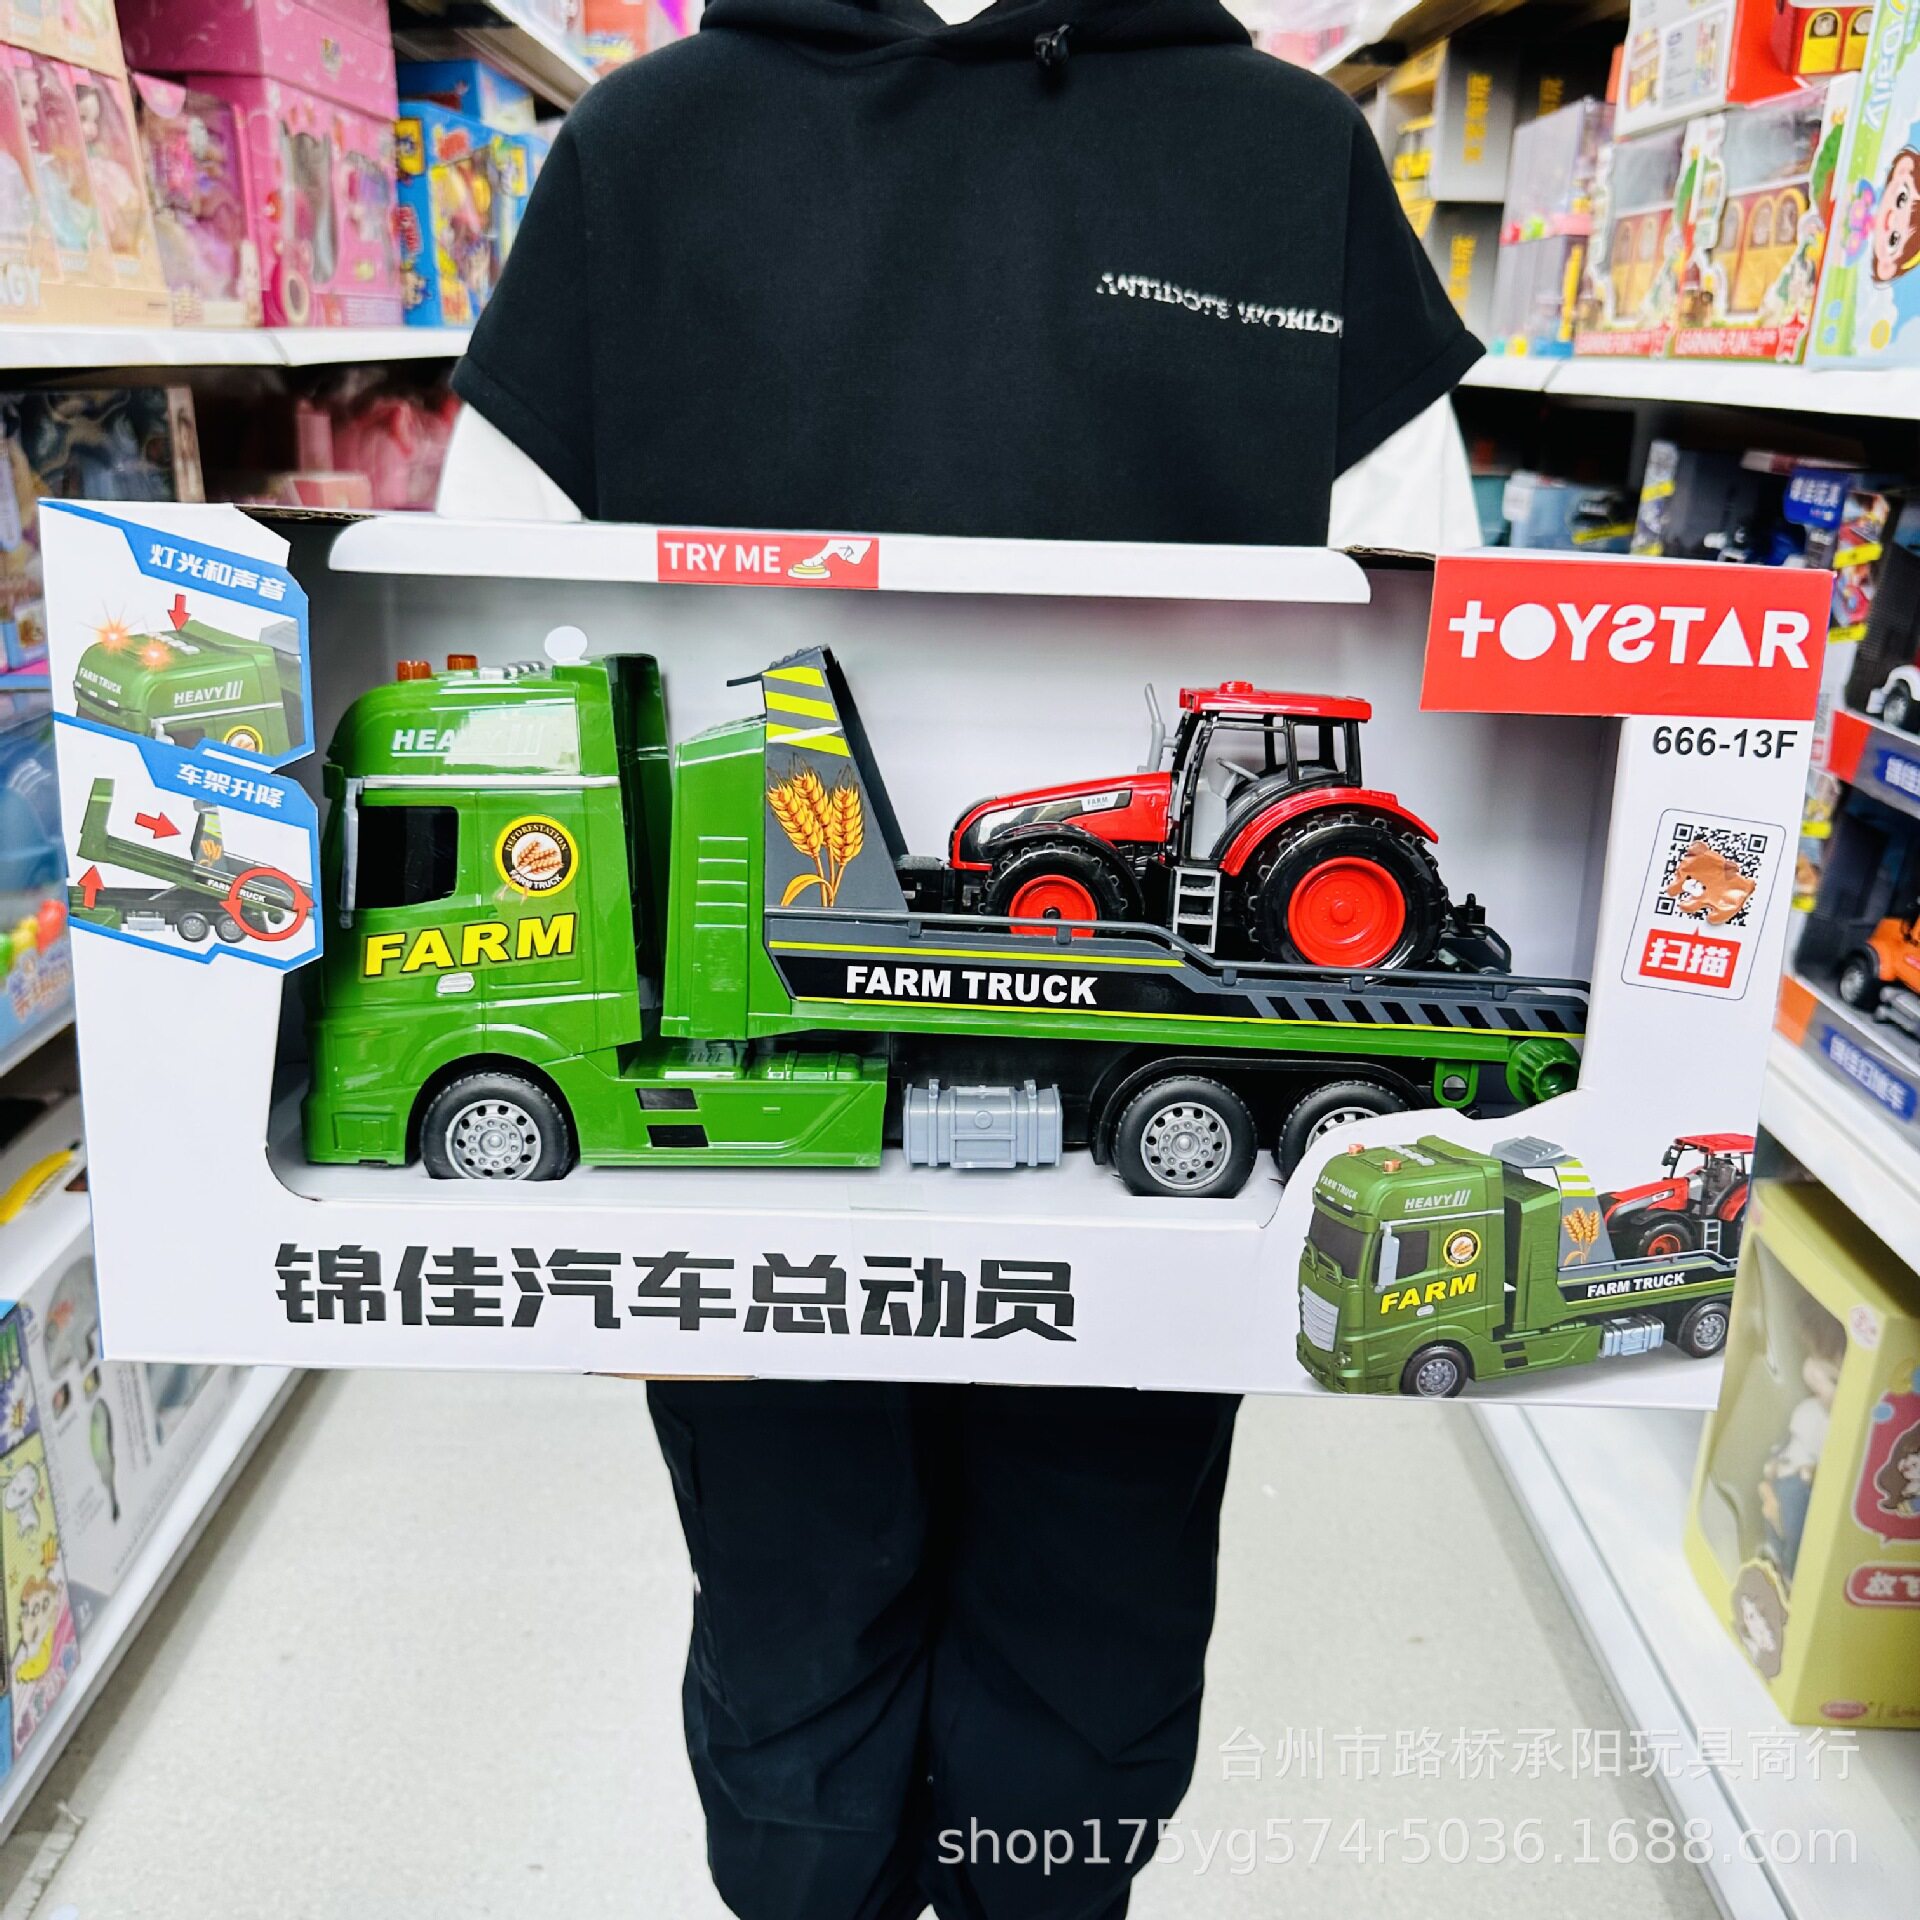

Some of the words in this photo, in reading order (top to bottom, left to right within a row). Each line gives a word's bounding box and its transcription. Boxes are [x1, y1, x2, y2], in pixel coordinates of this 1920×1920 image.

[149, 543, 287, 602] 灯光和声音
[663, 541, 727, 572] TRY
[735, 544, 781, 574] ME
[79, 667, 99, 684] FARM
[99, 674, 122, 696] TRUCK
[174, 686, 225, 706] HEAVY
[1652, 726, 1798, 759] 666-13F
[176, 763, 286, 809] 车架升降
[505, 823, 569, 852] DEFORESTATION
[239, 887, 267, 903] RUCK
[533, 874, 562, 890] TRUCK
[365, 914, 575, 977] FARM
[1645, 937, 1731, 979] 扫描
[846, 965, 952, 998] FARM
[961, 970, 1098, 1005] TRUCK
[1320, 1175, 1338, 1192] FARM
[1337, 1182, 1359, 1201] TRUCK
[1404, 1194, 1453, 1211] HEAVY
[273, 1243, 1078, 1342] 锦佳汽车总动员
[1380, 1270, 1478, 1315] FARM
[1587, 1279, 1630, 1298] FARM
[1633, 1272, 1685, 1292] TRUCK
